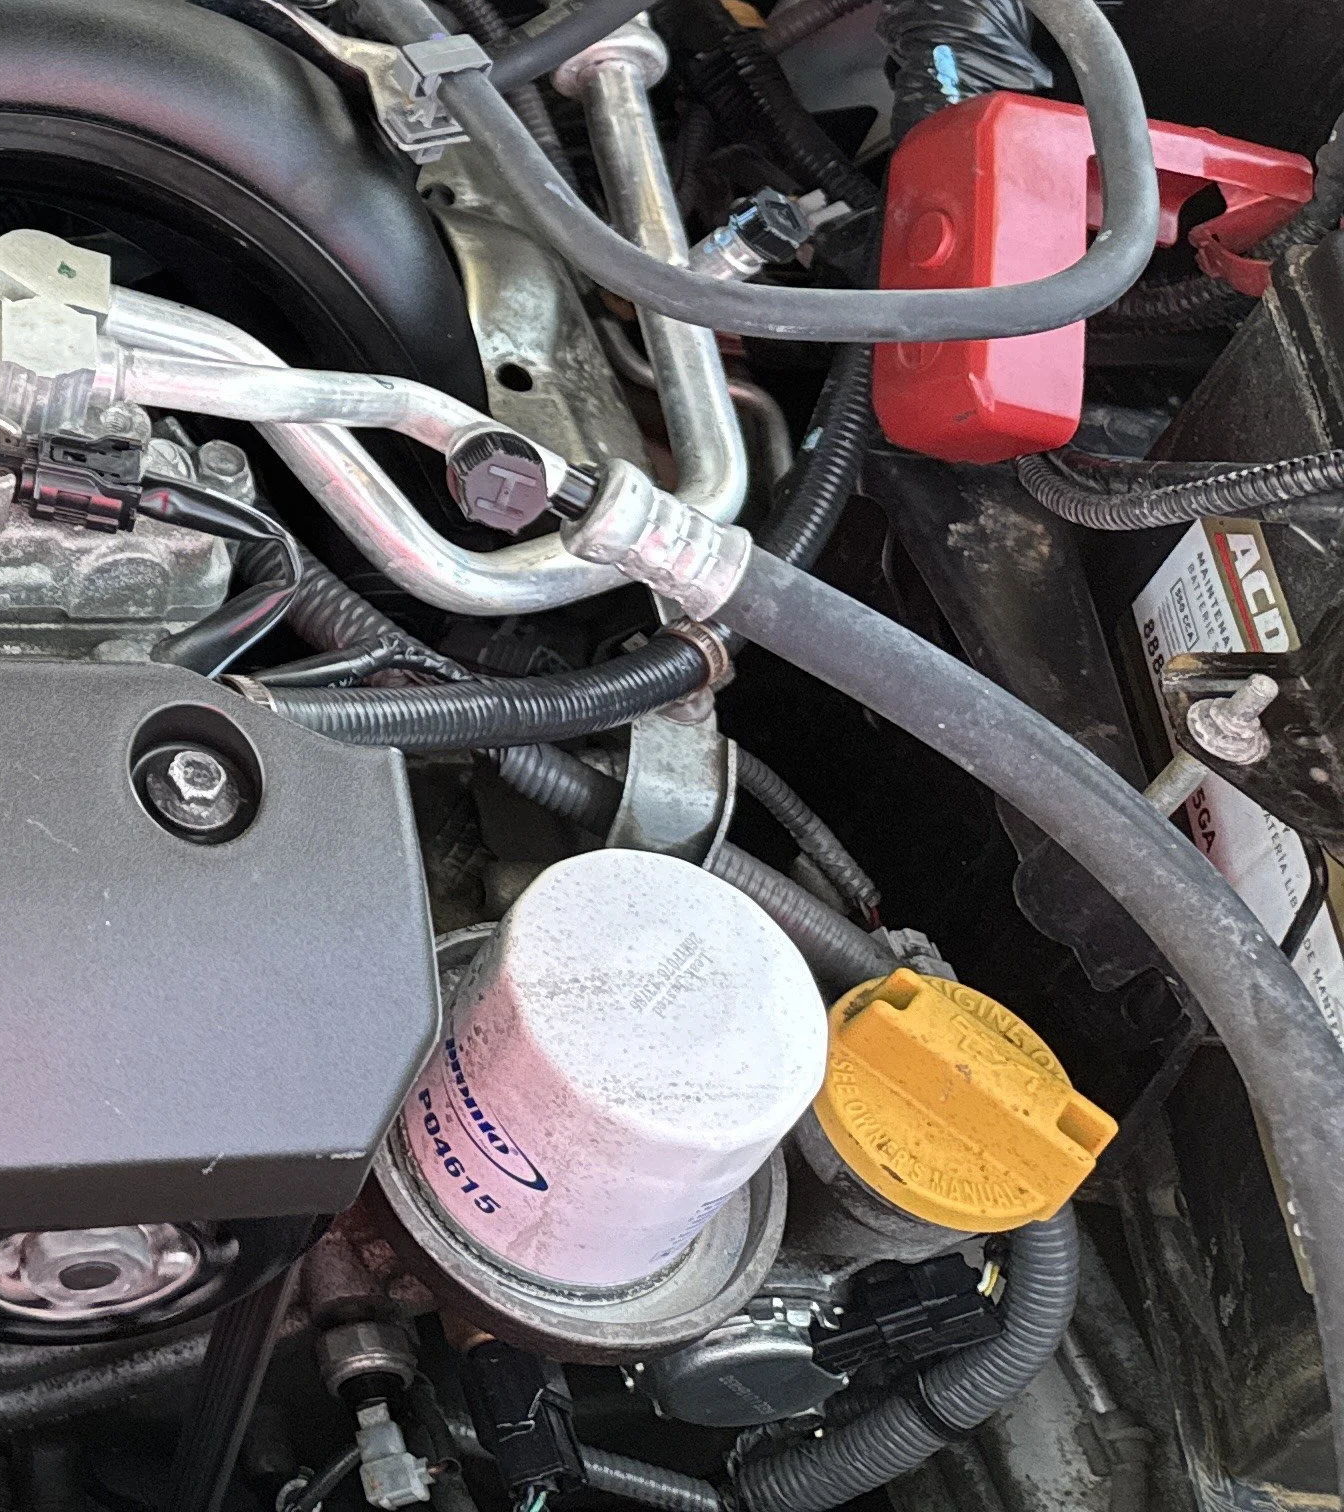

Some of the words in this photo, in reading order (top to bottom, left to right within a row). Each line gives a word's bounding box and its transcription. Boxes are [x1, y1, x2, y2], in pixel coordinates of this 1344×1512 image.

[1186, 562, 1215, 639] BATTERIE
[1182, 613, 1195, 642] CCA
[1301, 936, 1316, 963] DE
[831, 1055, 856, 1096] SEE
[928, 1171, 1029, 1209] MANUAL
